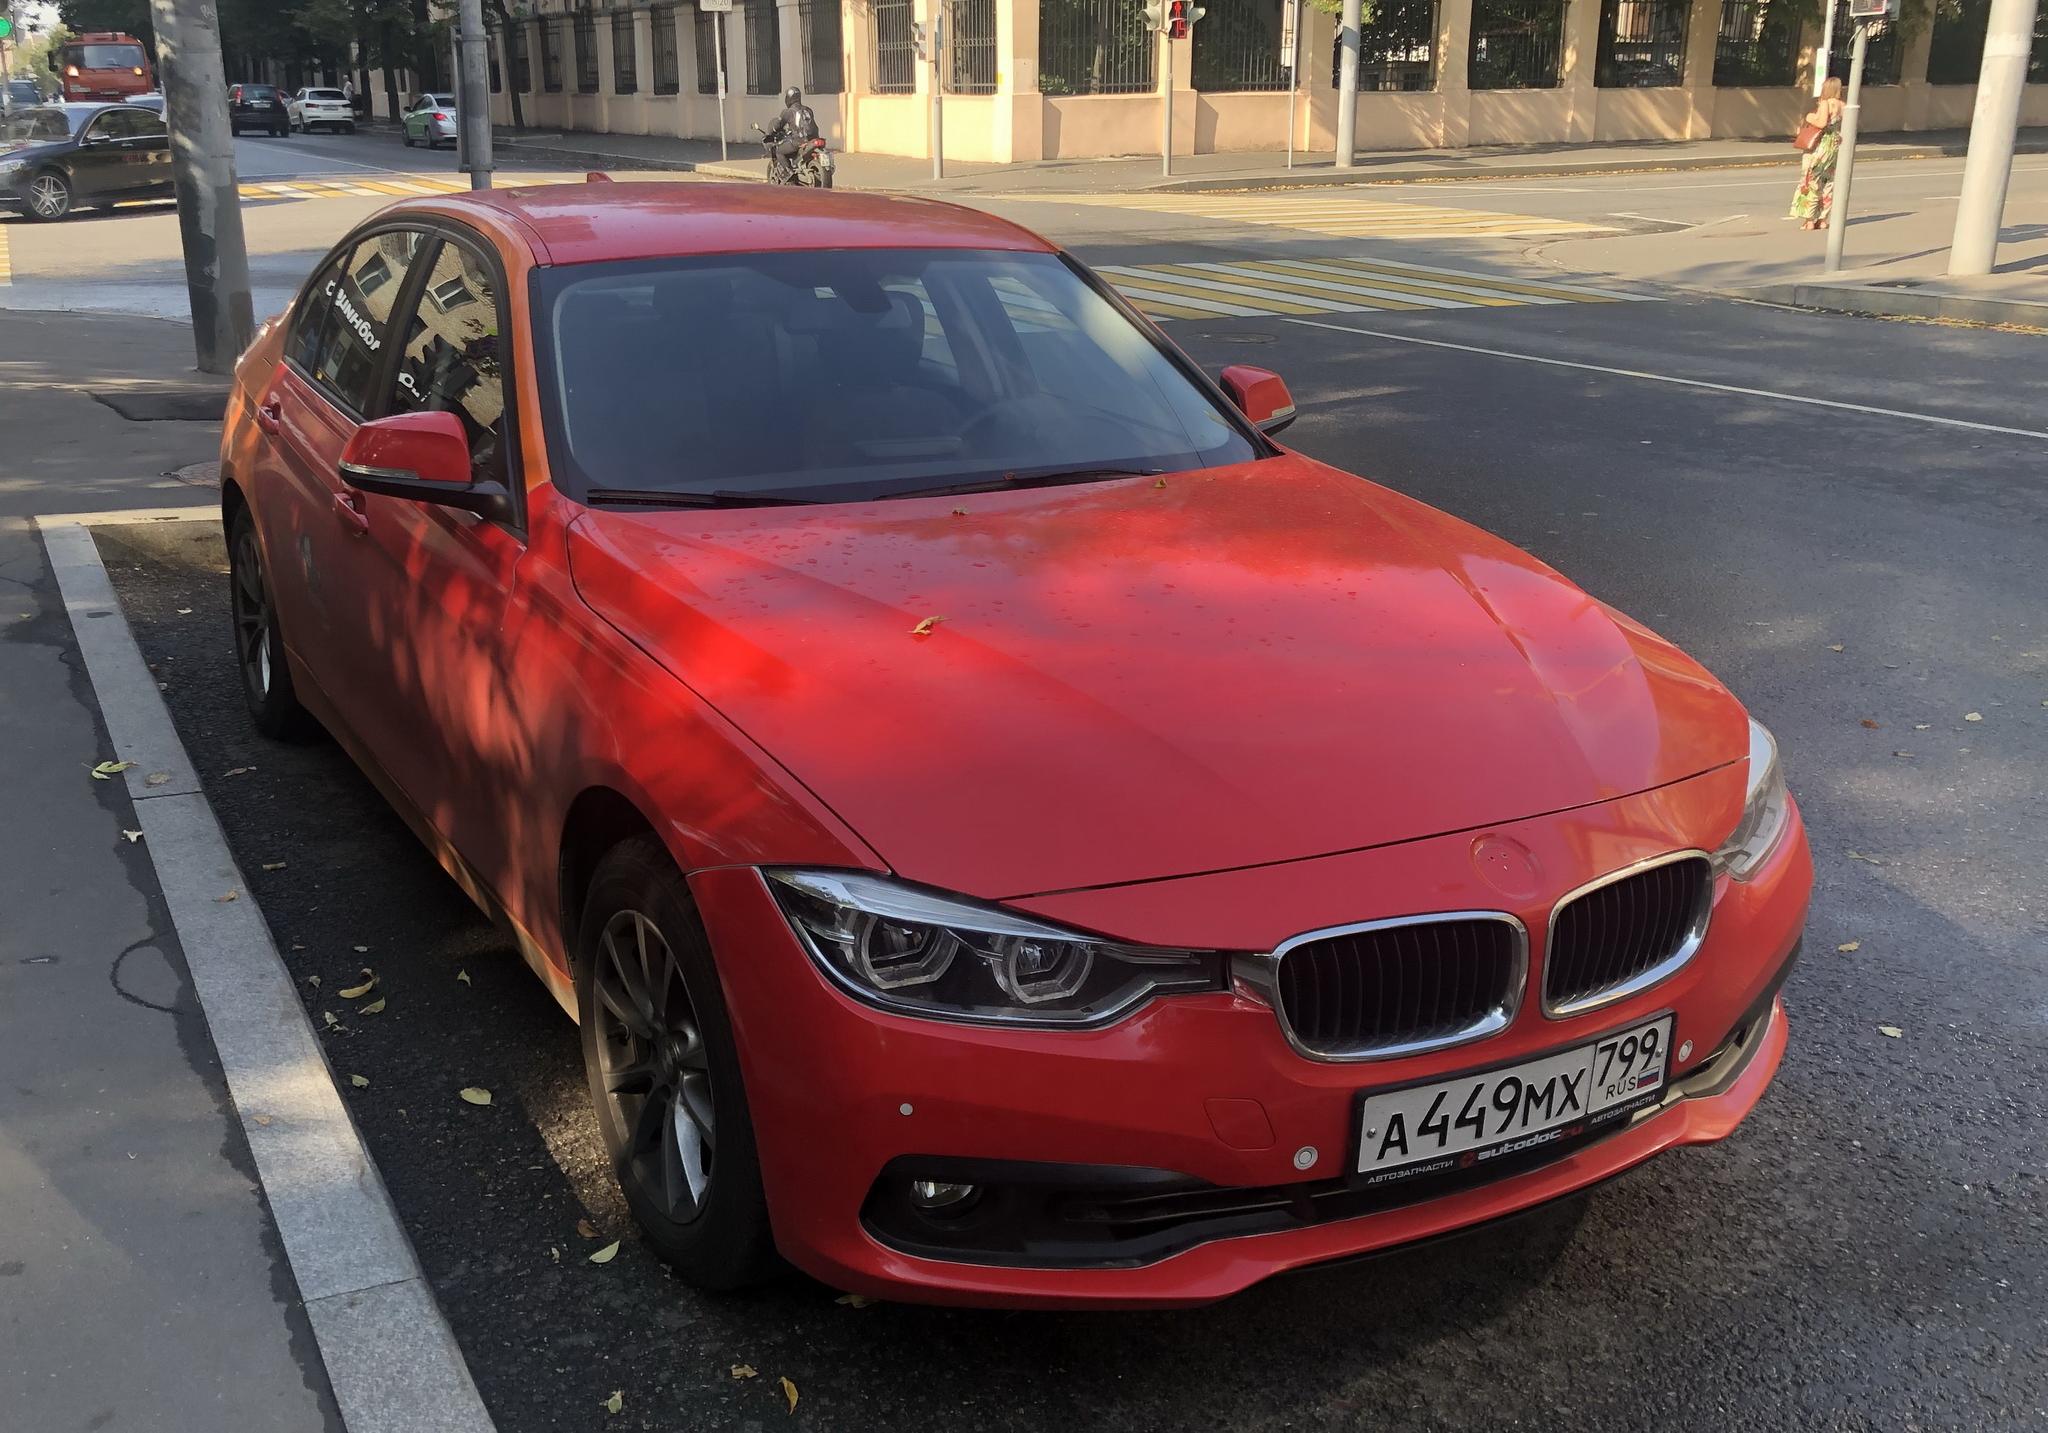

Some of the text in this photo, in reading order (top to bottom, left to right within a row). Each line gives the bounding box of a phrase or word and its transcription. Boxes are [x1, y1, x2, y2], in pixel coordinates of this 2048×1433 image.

[1598, 1028, 1659, 1088] 799
[1606, 1076, 1636, 1100] RUS
[1591, 1094, 1656, 1124] АВТОЗАПЧАСТИ
[1367, 1160, 1454, 1184] АВТОЗАПЧАСТИ
